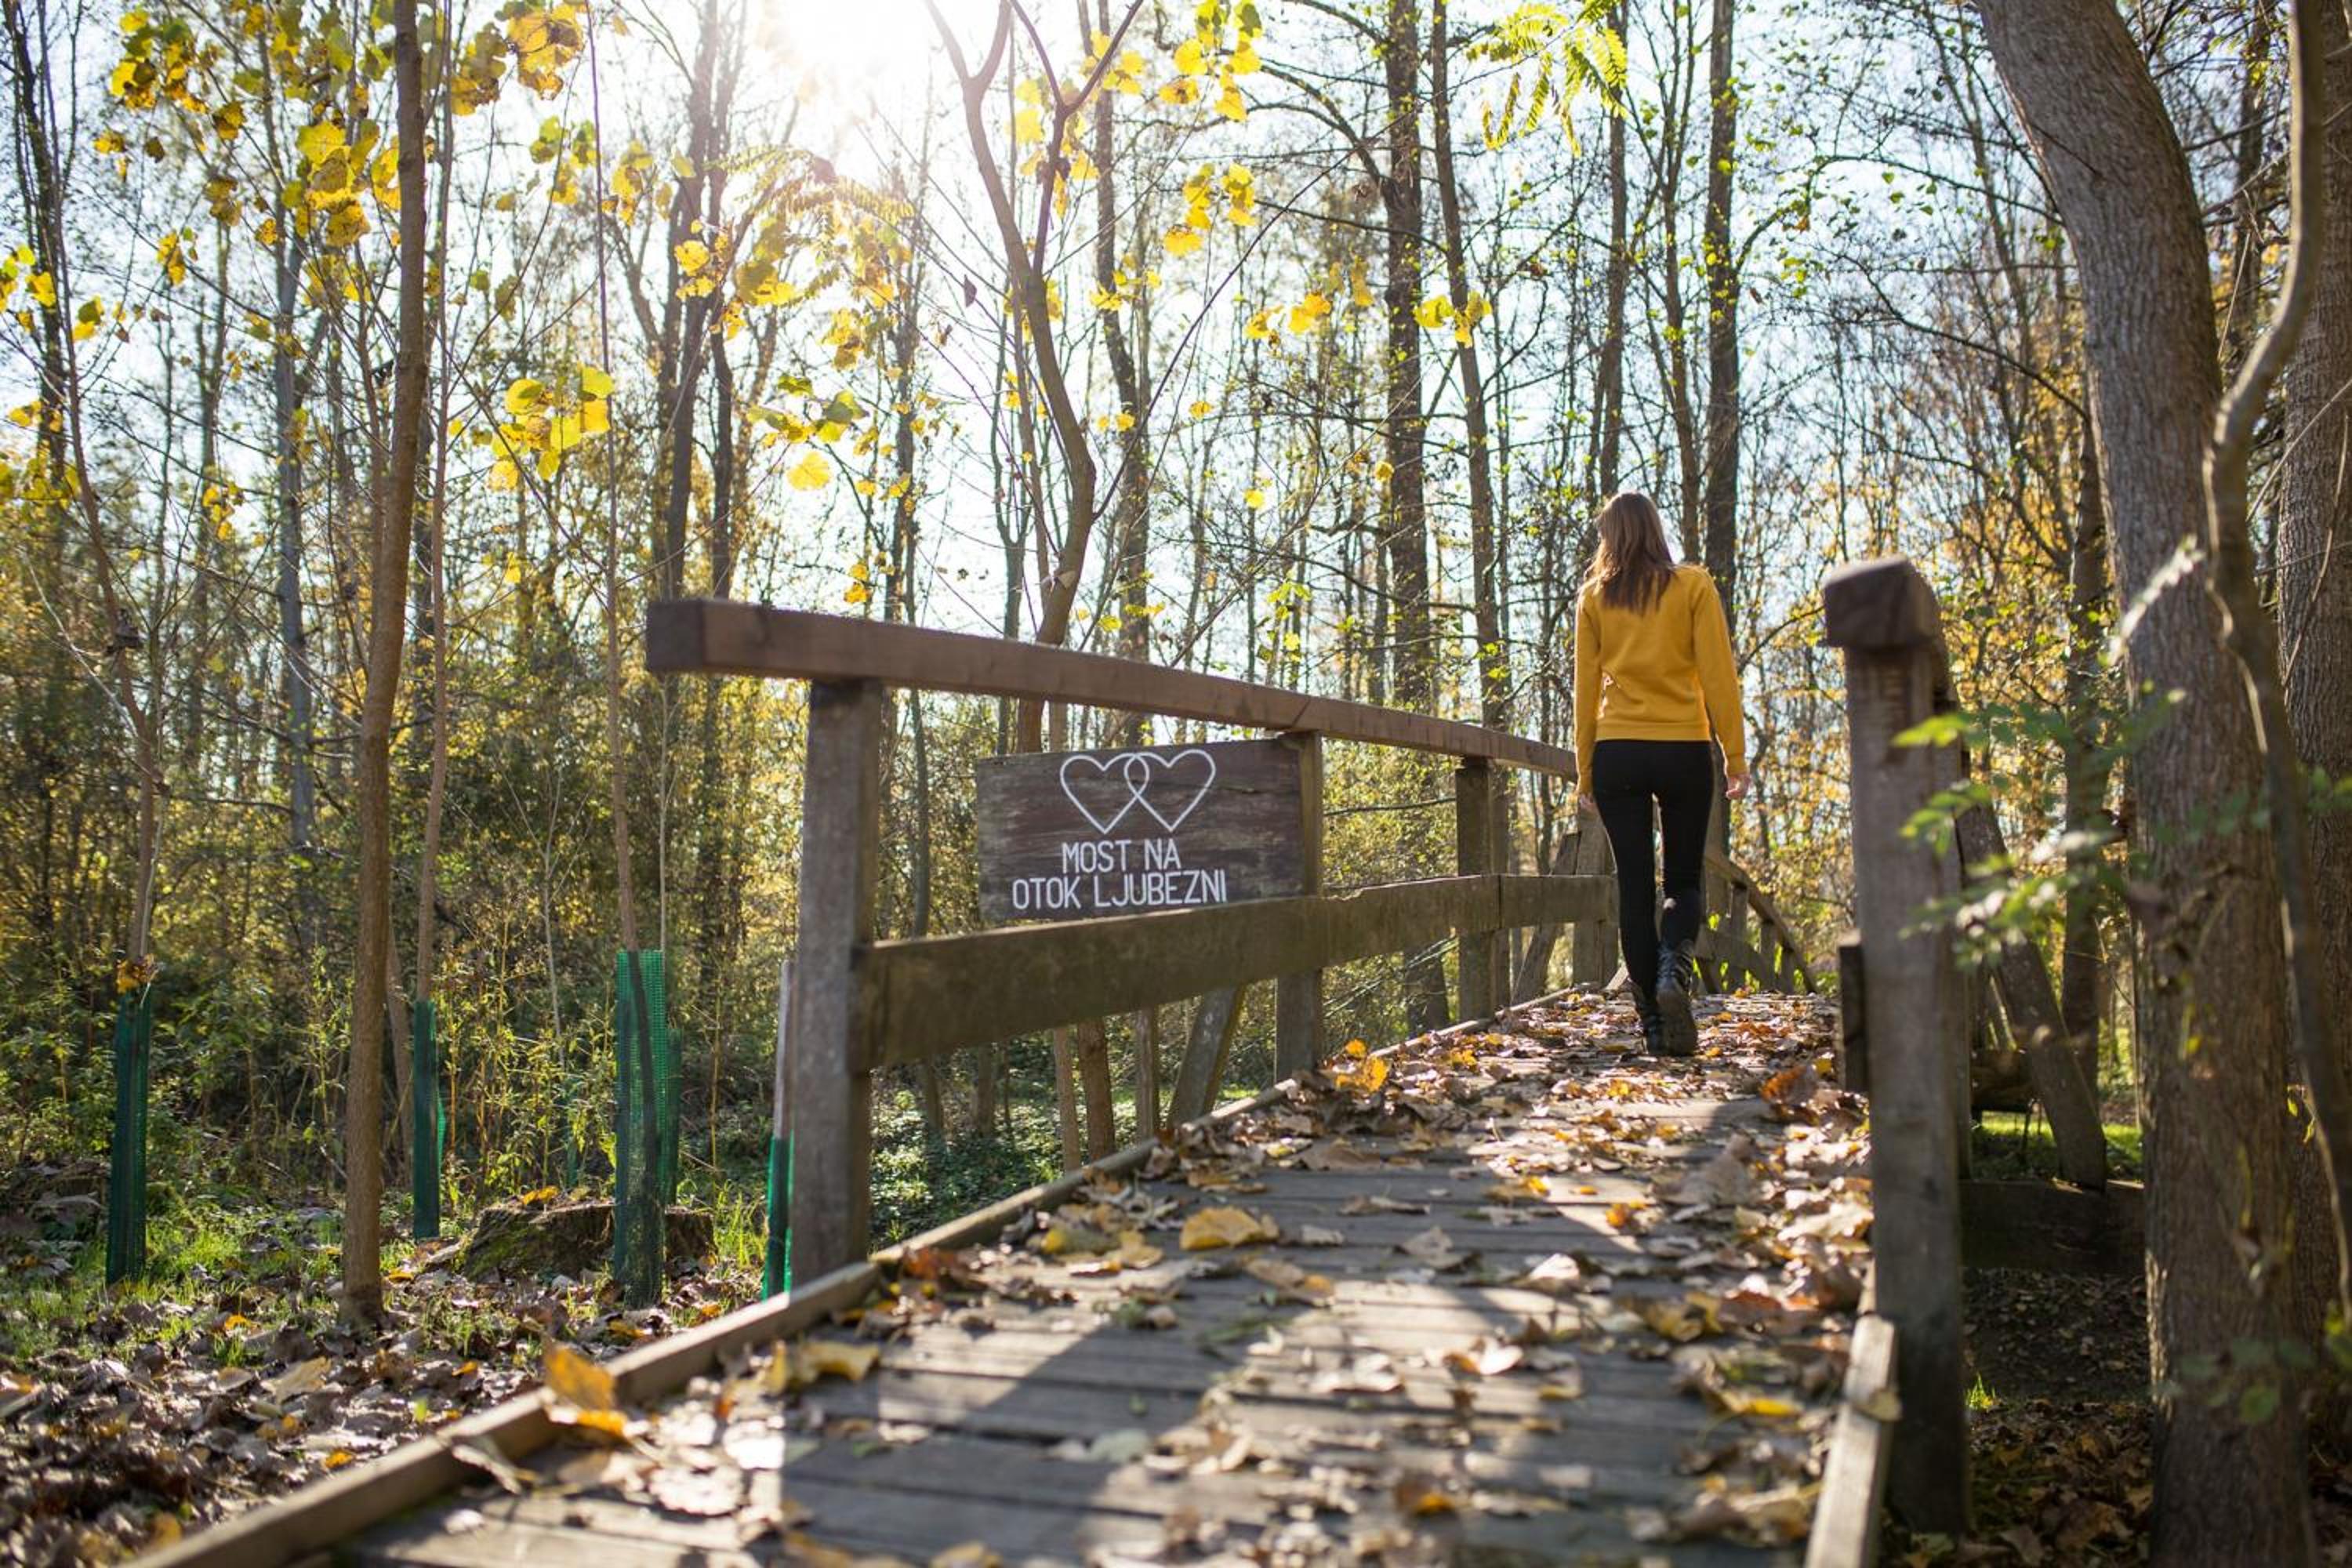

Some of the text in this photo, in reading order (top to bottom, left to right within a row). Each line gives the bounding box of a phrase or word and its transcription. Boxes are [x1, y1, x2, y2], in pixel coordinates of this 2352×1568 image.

[1062, 838, 1181, 873] MOST NA
[1012, 869, 1227, 909] OTOK LJUBEZNI
